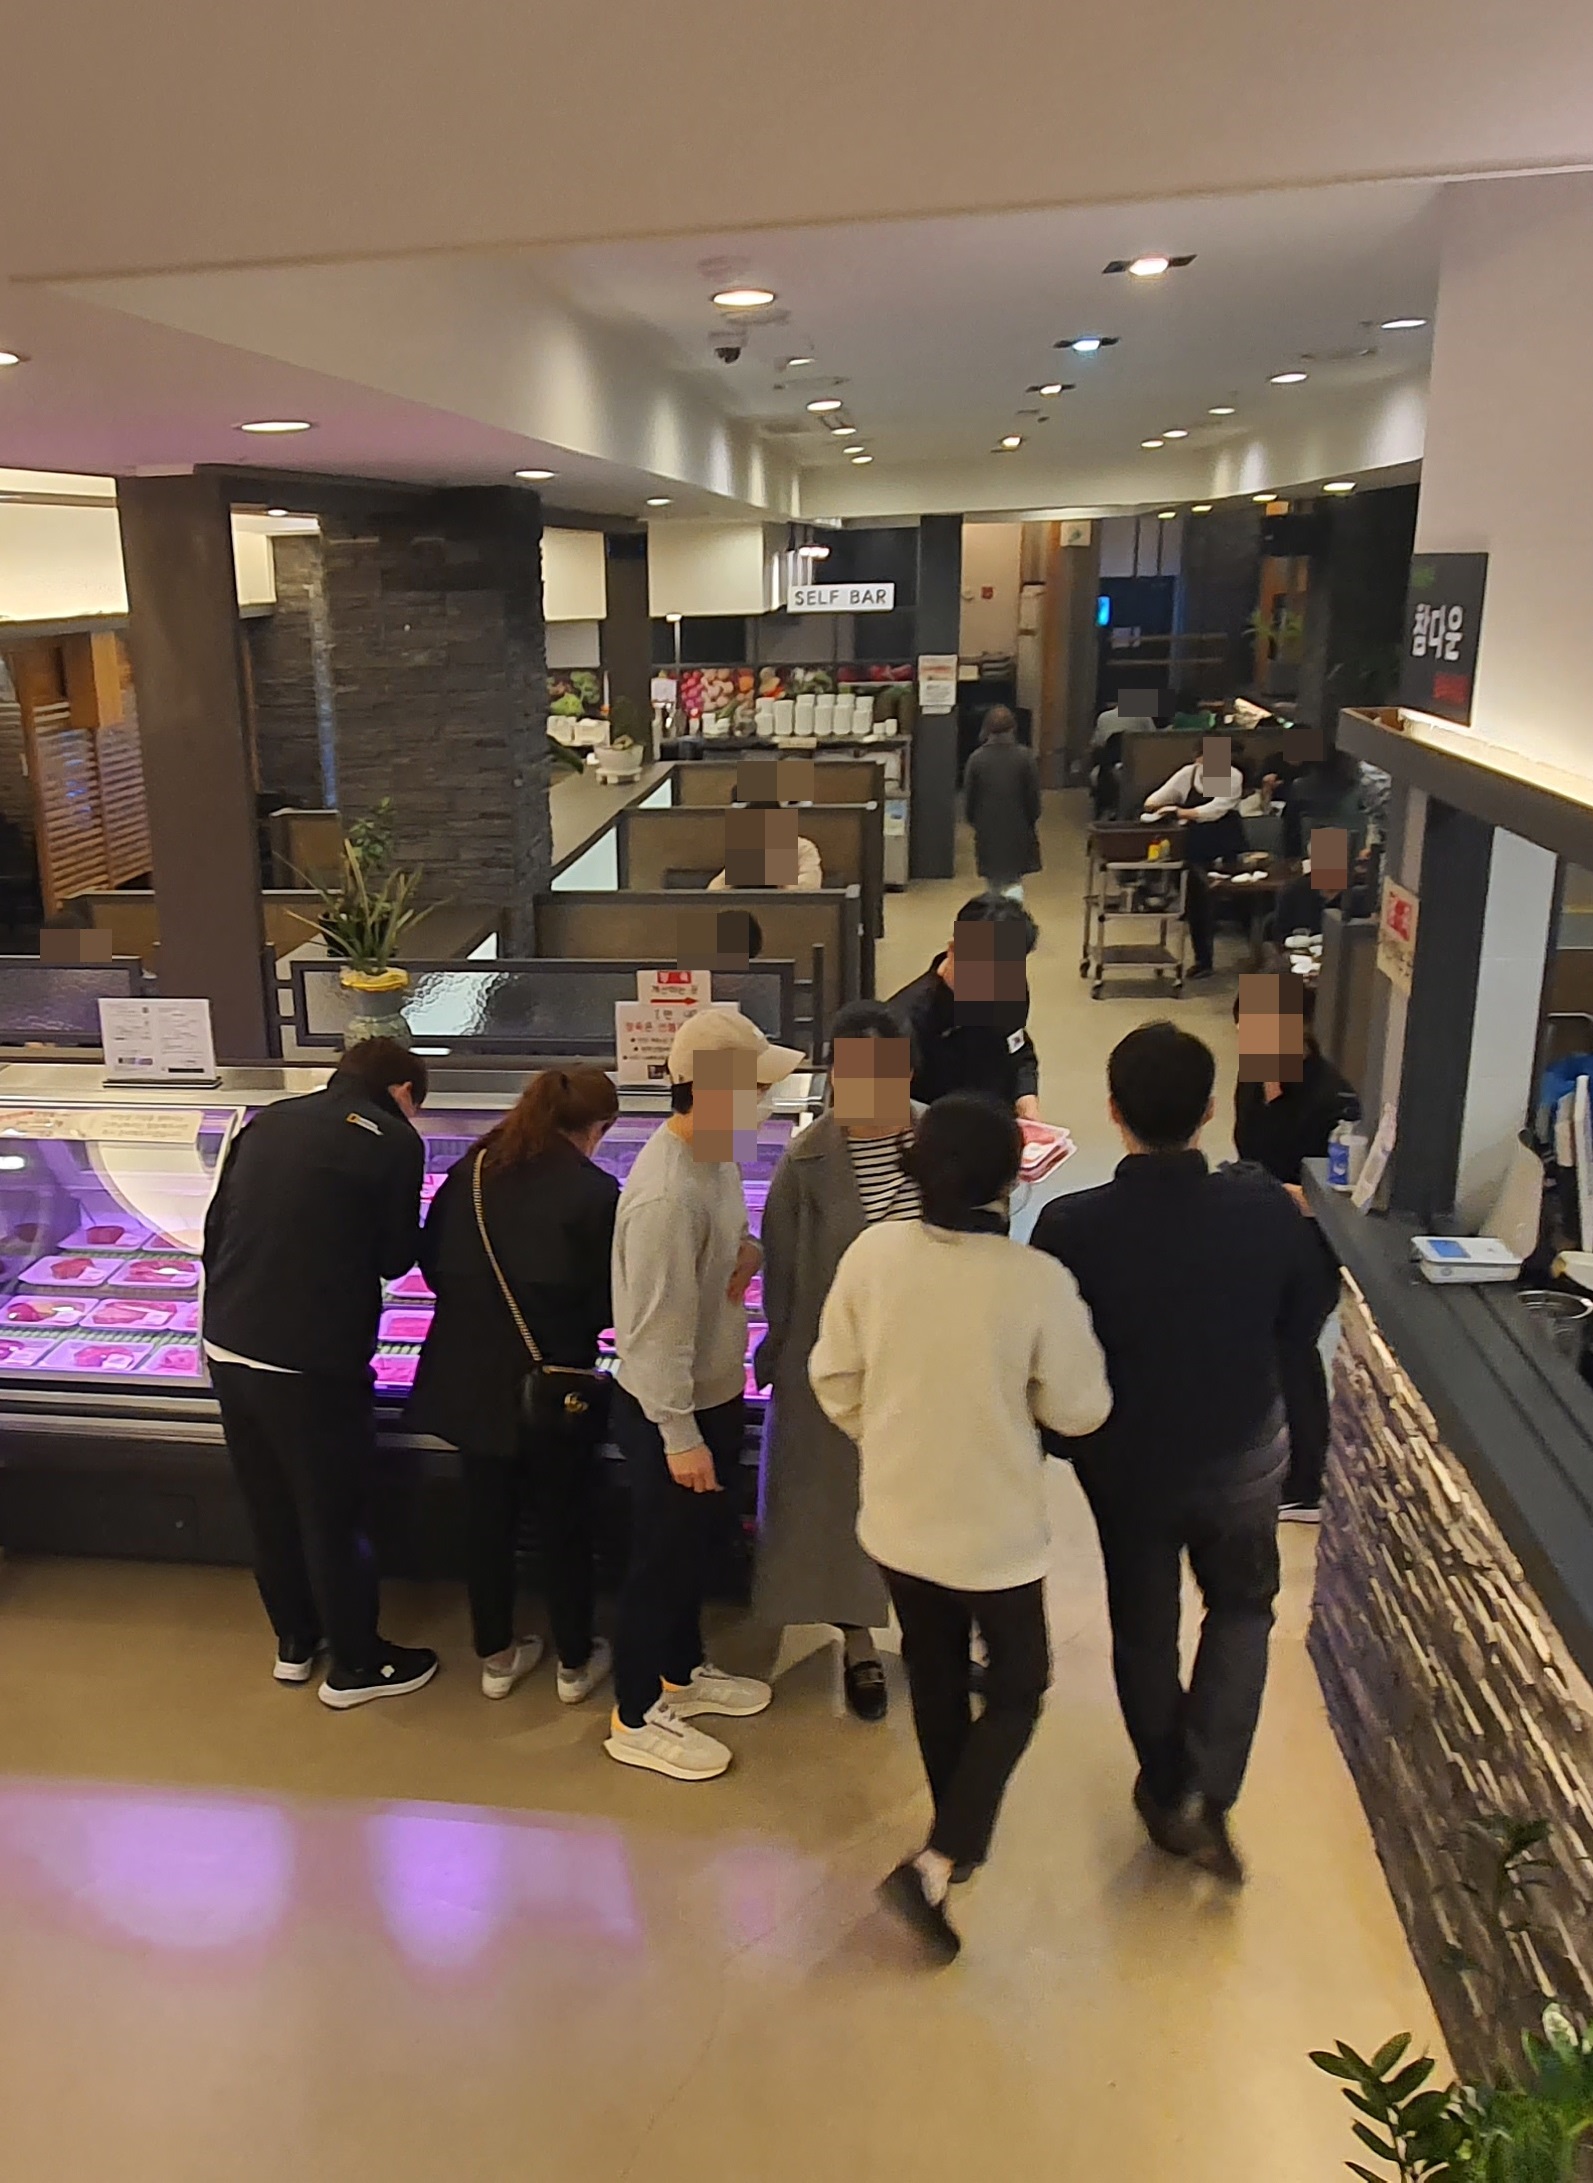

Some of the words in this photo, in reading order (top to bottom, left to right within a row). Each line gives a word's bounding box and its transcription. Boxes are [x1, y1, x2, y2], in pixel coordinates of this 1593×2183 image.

[795, 590, 840, 606] SELF
[849, 589, 887, 605] BAR
[1412, 603, 1463, 660] 참다운
